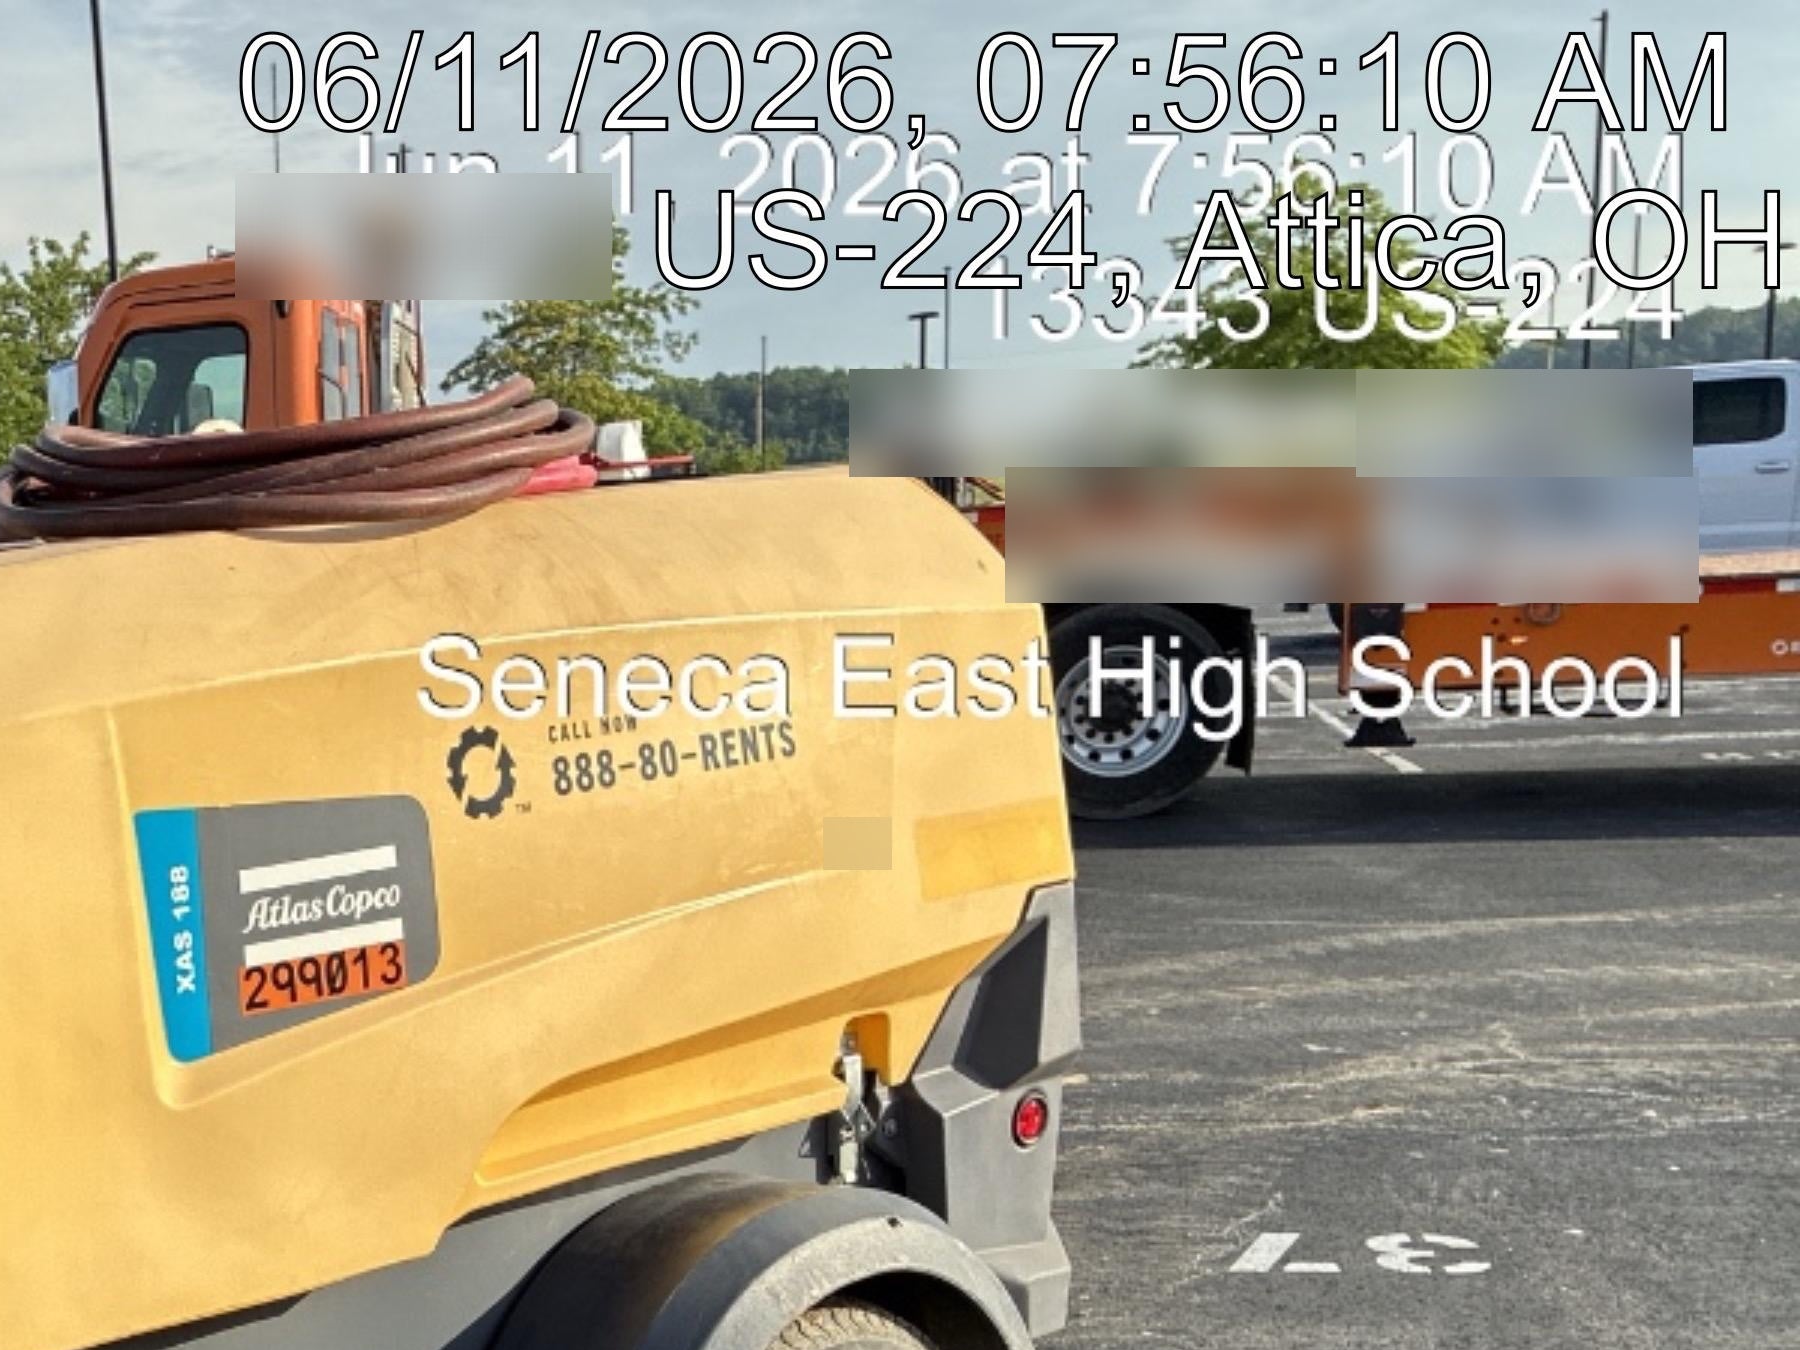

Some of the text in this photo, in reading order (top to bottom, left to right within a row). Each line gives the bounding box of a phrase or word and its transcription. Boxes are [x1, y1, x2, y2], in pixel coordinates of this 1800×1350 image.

[547, 714, 639, 744] CALL NOW
[551, 720, 798, 796] 888-80-RENTS
[169, 863, 197, 994] XAS 188
[242, 883, 402, 934] Atlas Copco
[242, 940, 405, 1012] 299013
